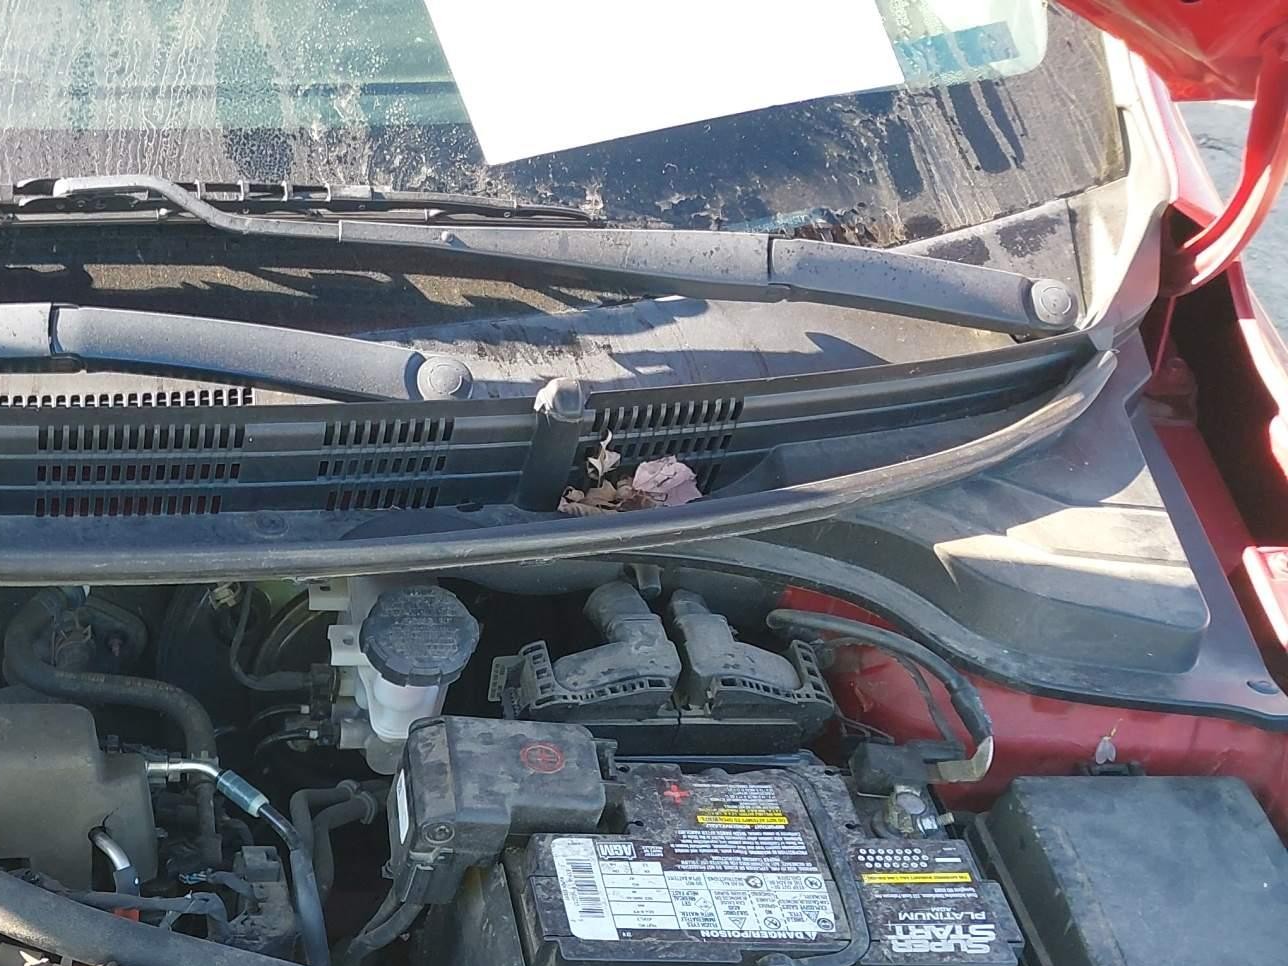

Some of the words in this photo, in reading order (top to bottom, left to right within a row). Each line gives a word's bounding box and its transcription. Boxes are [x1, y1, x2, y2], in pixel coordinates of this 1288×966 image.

[599, 844, 632, 857] AGM
[898, 911, 986, 921] PLATINUM
[700, 930, 805, 941] DANGER/POISON
[885, 924, 996, 942] START
[891, 939, 990, 954] SUPER
